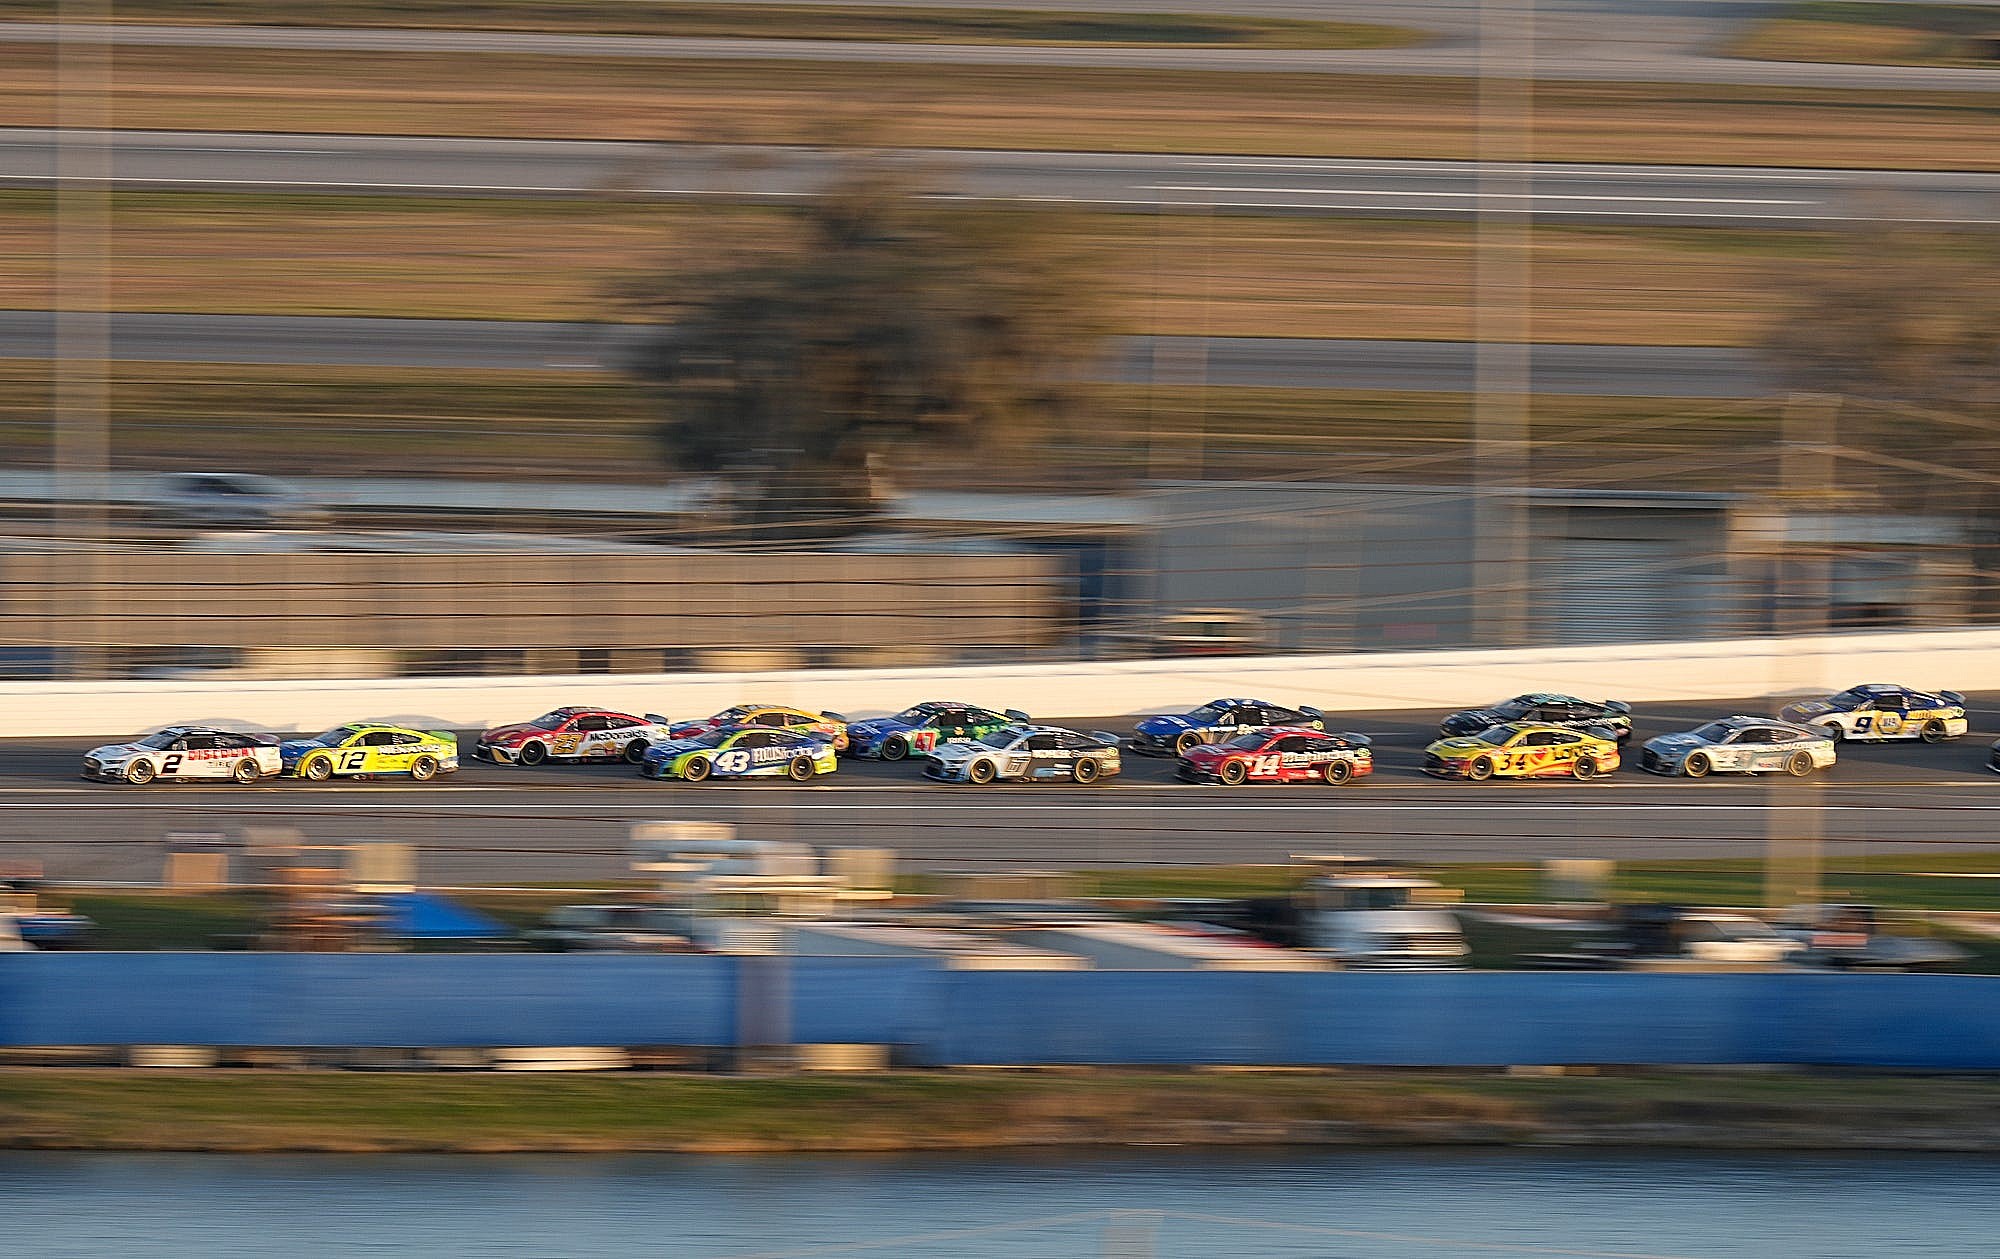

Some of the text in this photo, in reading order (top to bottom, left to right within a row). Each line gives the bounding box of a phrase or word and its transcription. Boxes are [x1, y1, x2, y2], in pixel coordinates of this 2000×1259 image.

[1855, 717, 1873, 734] 9
[914, 732, 936, 752] 47
[161, 754, 183, 773] 2
[339, 752, 367, 769] 12
[715, 751, 750, 773] 43
[1250, 755, 1281, 776] 14
[1500, 754, 1526, 771] 34
